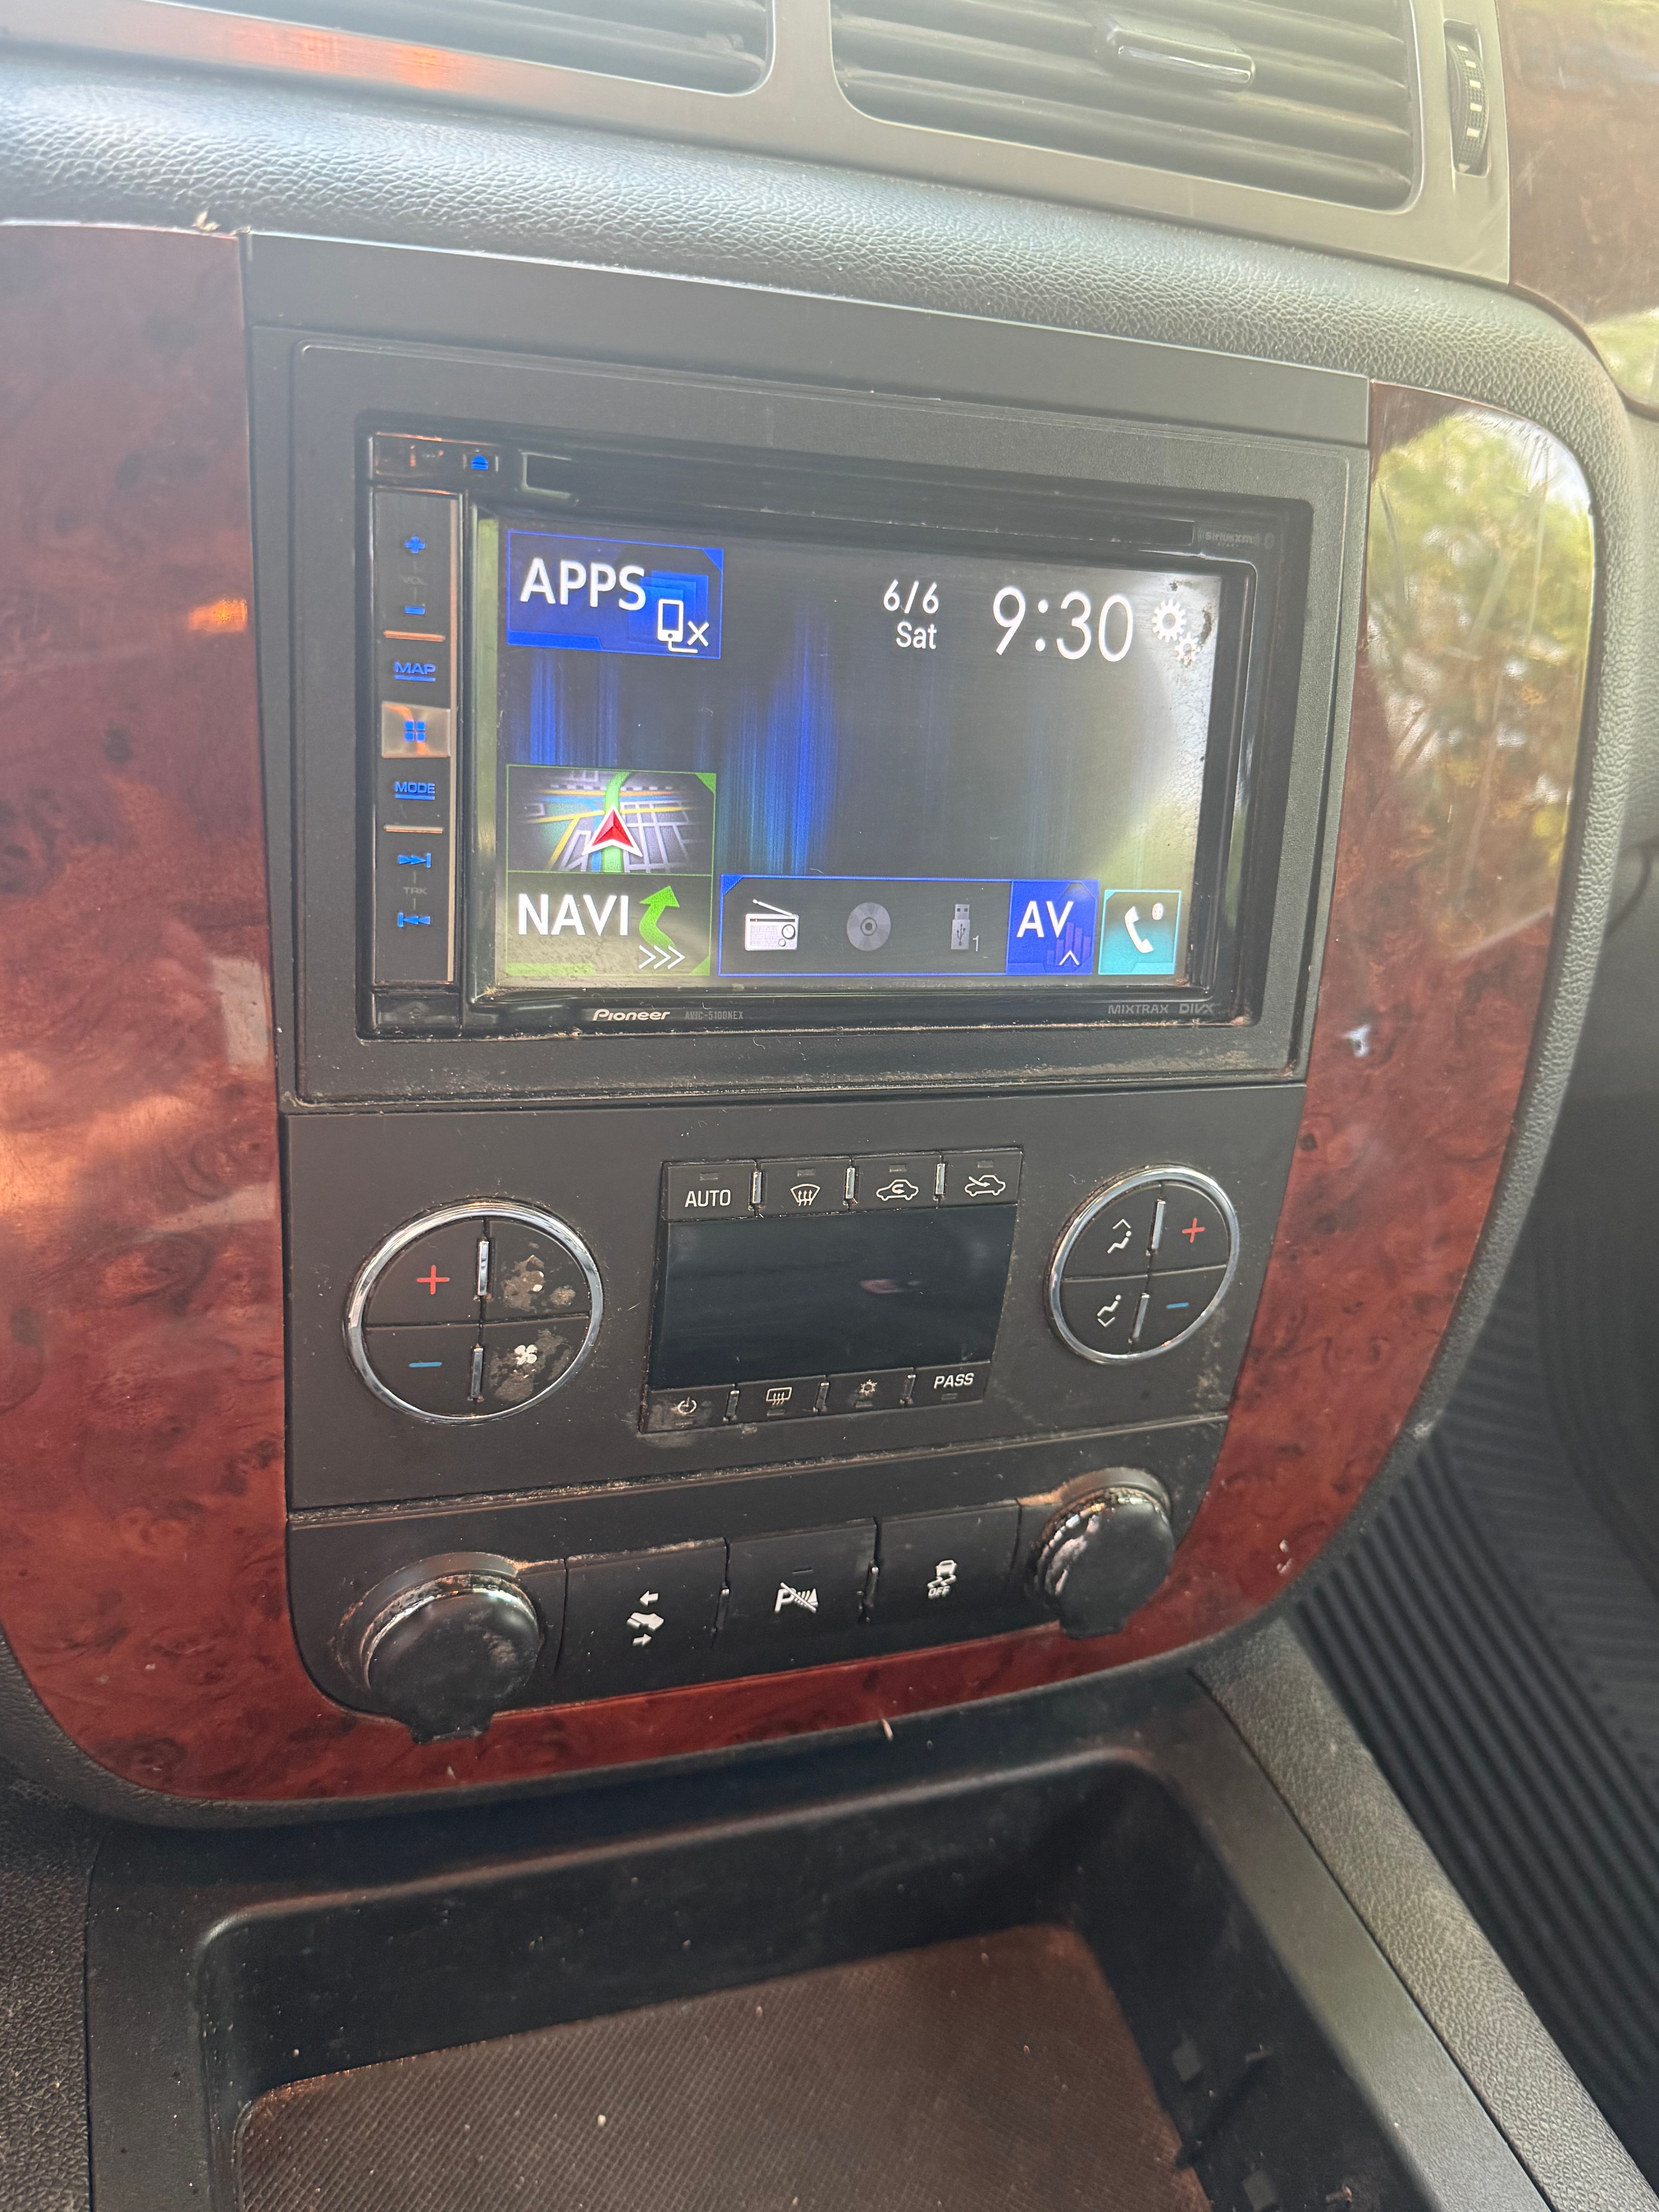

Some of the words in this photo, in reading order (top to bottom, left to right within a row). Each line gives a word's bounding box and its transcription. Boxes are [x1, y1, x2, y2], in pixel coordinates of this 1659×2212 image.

[520, 557, 646, 610] APPS
[883, 579, 939, 614] 6/6
[993, 586, 1133, 662] 9:30
[896, 622, 937, 649] Sat
[394, 661, 436, 675] MAP
[395, 781, 435, 794] MODE
[519, 893, 629, 936] NAVI
[1017, 901, 1073, 938] AV
[592, 1008, 670, 1021] Pioneer
[1108, 1004, 1169, 1015] MIXTRAX
[685, 1190, 731, 1207] AUTO
[934, 1372, 974, 1389] PASS
[928, 1585, 950, 1599] OFF
